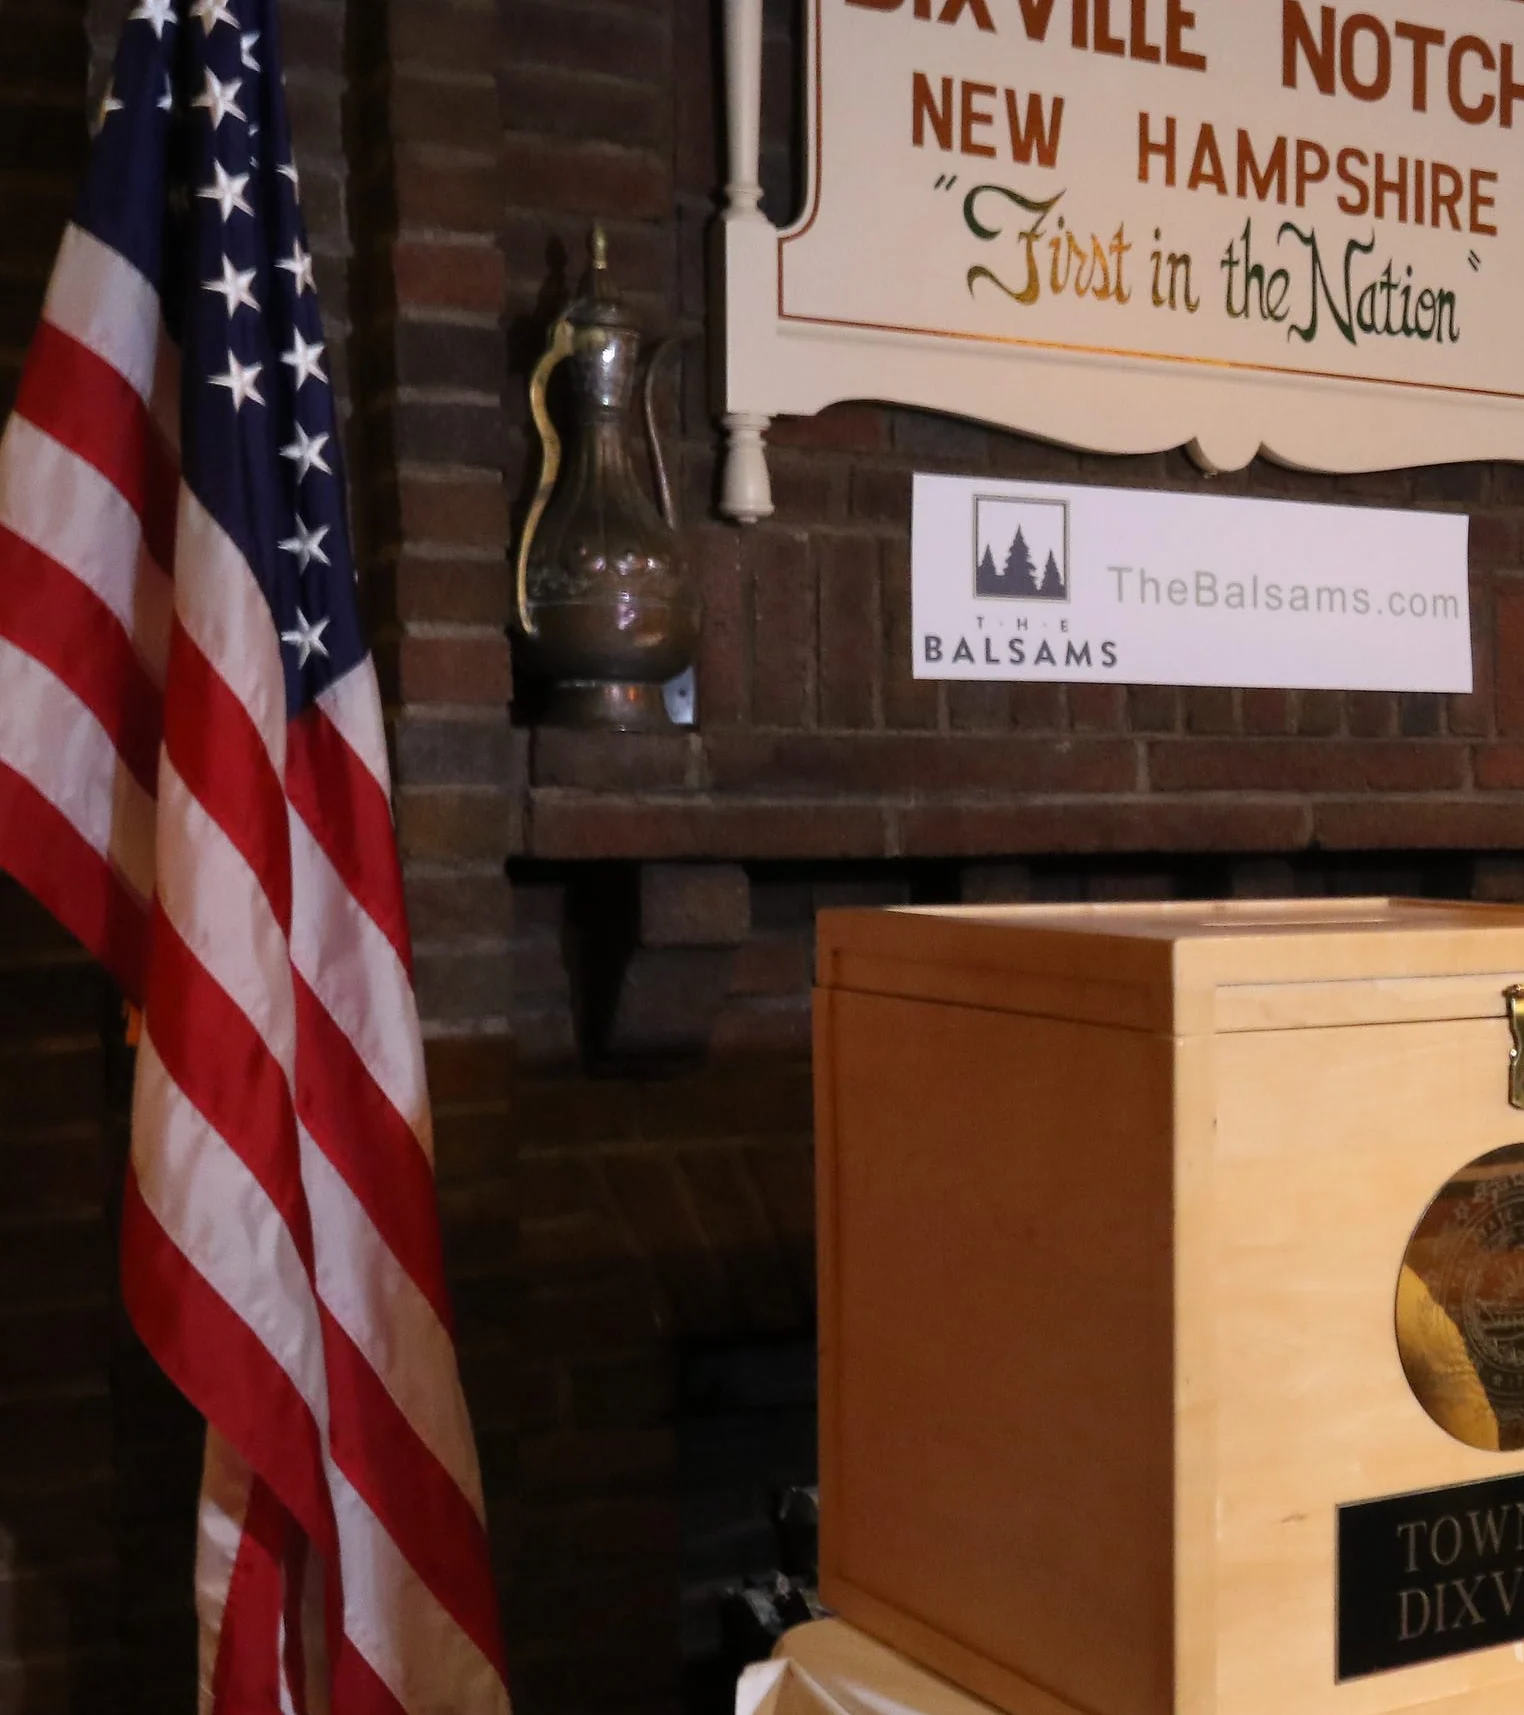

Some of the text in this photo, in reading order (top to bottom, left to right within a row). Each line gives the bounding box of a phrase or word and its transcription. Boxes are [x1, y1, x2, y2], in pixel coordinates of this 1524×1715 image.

[844, 0, 1208, 72] ILLE
[910, 71, 1499, 237] NEW HAMPSHIRE
[1150, 228, 1200, 314] in
[1220, 217, 1291, 320] the
[1107, 566, 1461, 620] TheBalsams.com
[924, 635, 1118, 669] BALSAMS
